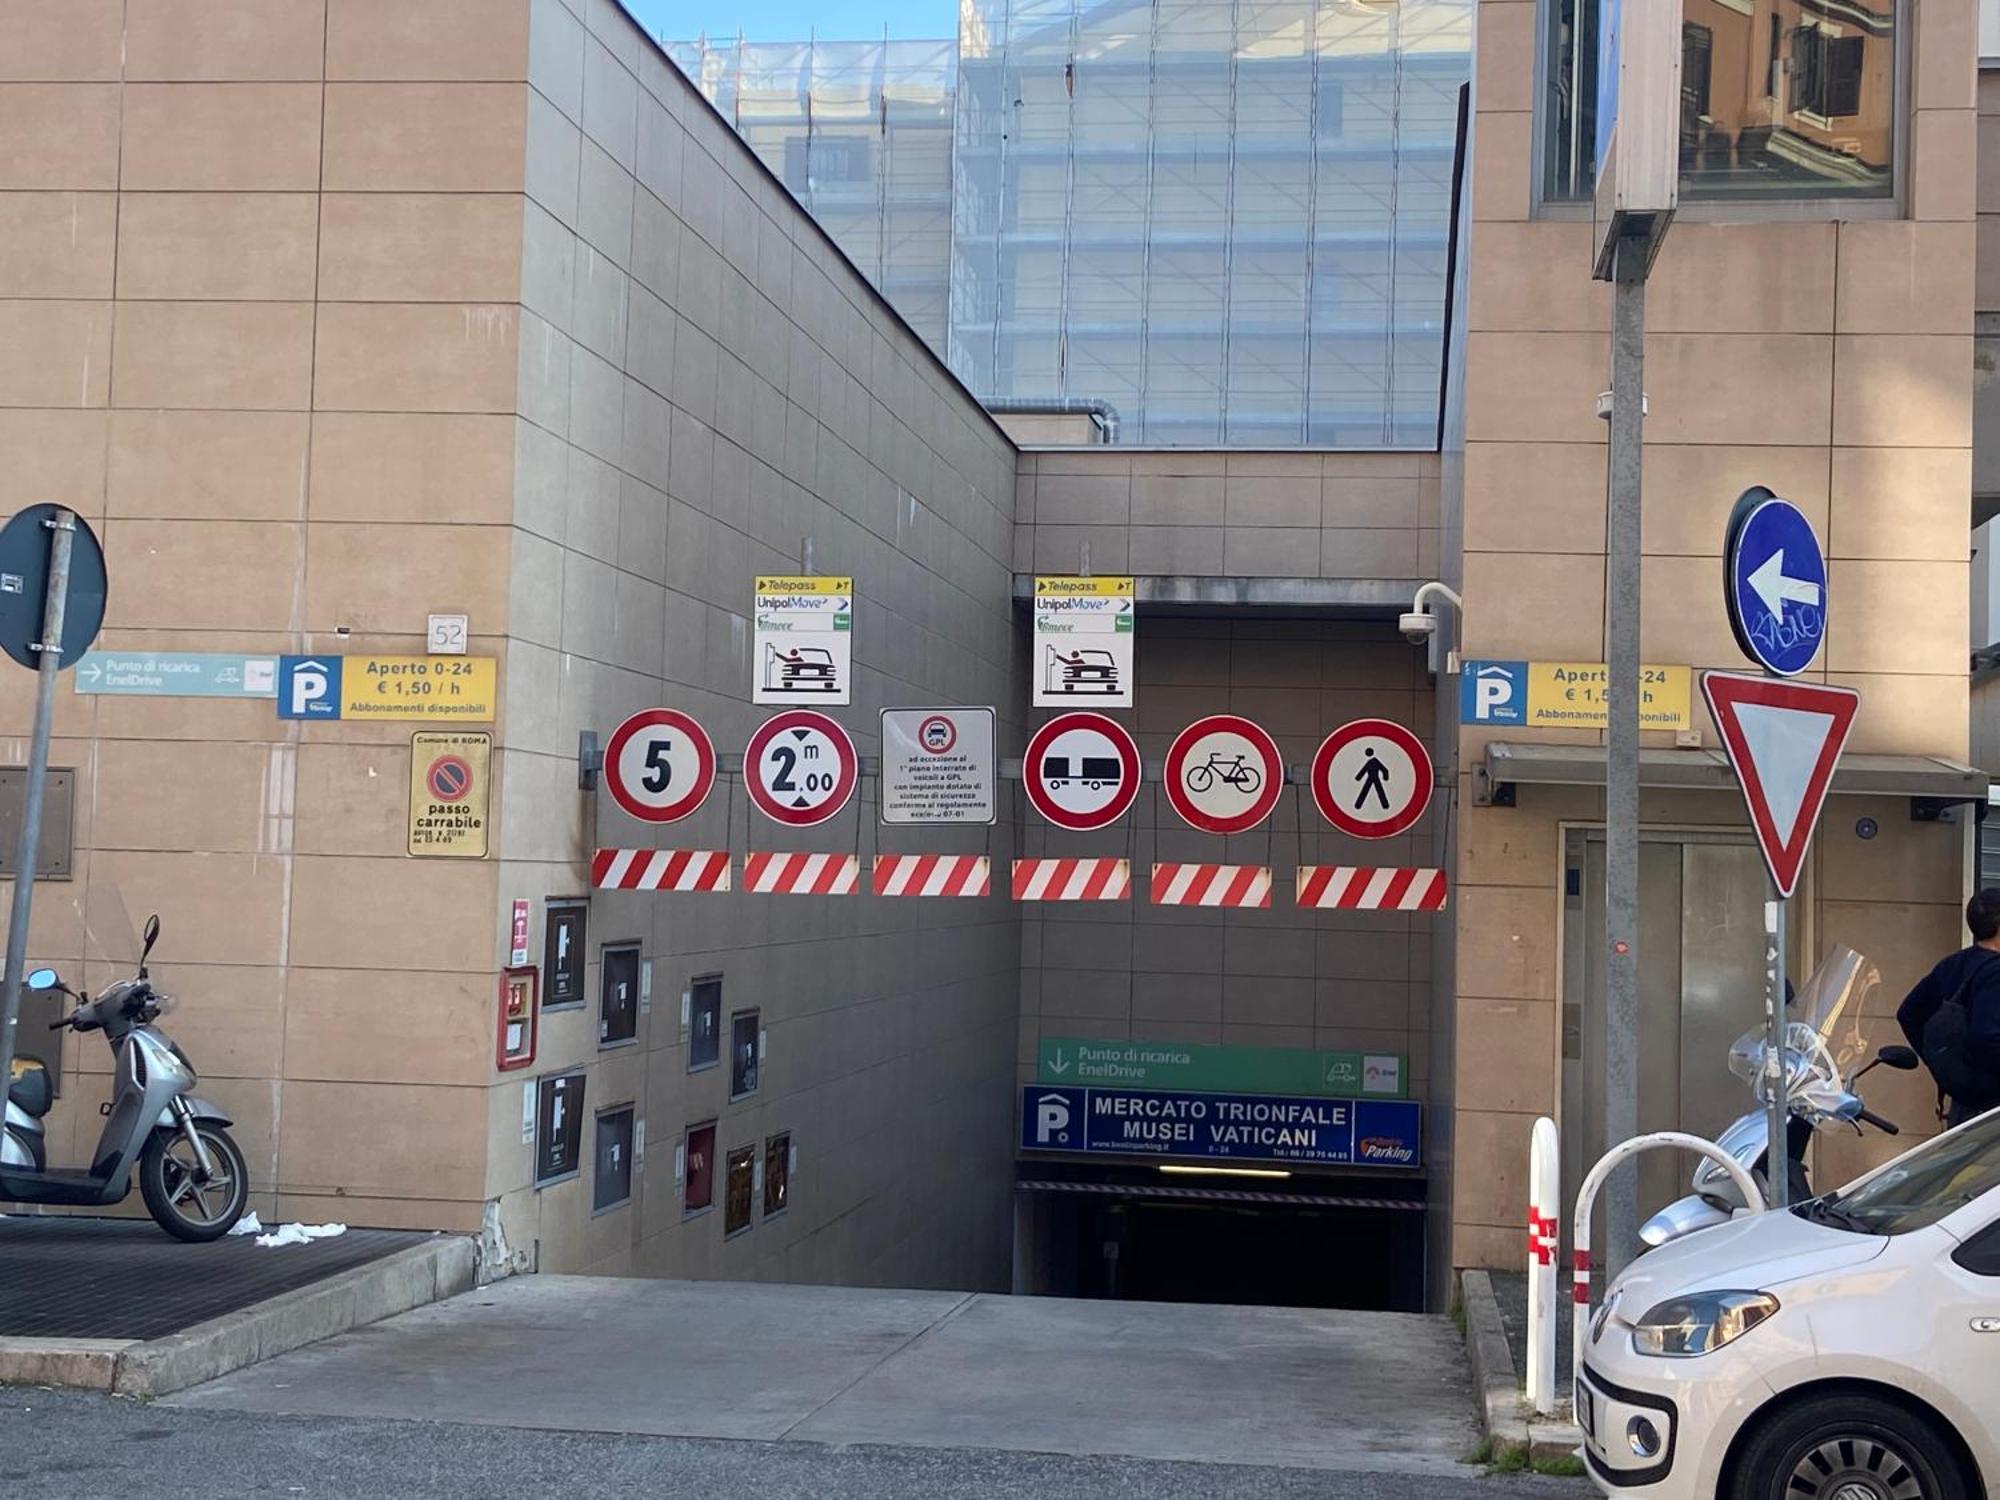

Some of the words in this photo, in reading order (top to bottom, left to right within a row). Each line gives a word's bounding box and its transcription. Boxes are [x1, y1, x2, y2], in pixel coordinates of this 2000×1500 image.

[768, 581, 816, 591] Telepass
[1048, 581, 1097, 592] Telepass
[435, 624, 462, 646] 52
[106, 659, 142, 673] Punto
[144, 659, 156, 673] di
[158, 661, 200, 673] ricarica
[366, 662, 428, 676] Aperto
[434, 663, 472, 675] 0-24
[106, 675, 163, 687] EnelDrive
[1554, 668, 1607, 683] Apert
[292, 672, 327, 714] P
[376, 681, 387, 694] €
[396, 681, 432, 696] 1,50
[451, 681, 460, 694] h
[1476, 678, 1513, 719] P
[1566, 689, 1575, 701] €
[1585, 689, 1609, 704] 1,5
[1643, 692, 1653, 702] h
[350, 703, 425, 713] Abbonamenti
[427, 704, 486, 715] disponibili
[1536, 709, 1608, 720] Abbonamen
[641, 740, 672, 793] 5
[909, 764, 931, 773] piano
[910, 784, 944, 792] impianto
[428, 804, 470, 815] passo
[937, 801, 987, 809] regolamento
[417, 817, 481, 828] carrabile
[1078, 1047, 1120, 1062] Punto
[1123, 1049, 1137, 1062] di
[1140, 1052, 1190, 1065] ricarica
[1078, 1063, 1146, 1078] EnelDrive
[1095, 1097, 1206, 1119] MERCATO
[1215, 1102, 1346, 1125] TRIONFALE
[1123, 1121, 1194, 1141] MUSEI
[1210, 1124, 1317, 1147] VATICANI
[1365, 1144, 1413, 1162] Parking
